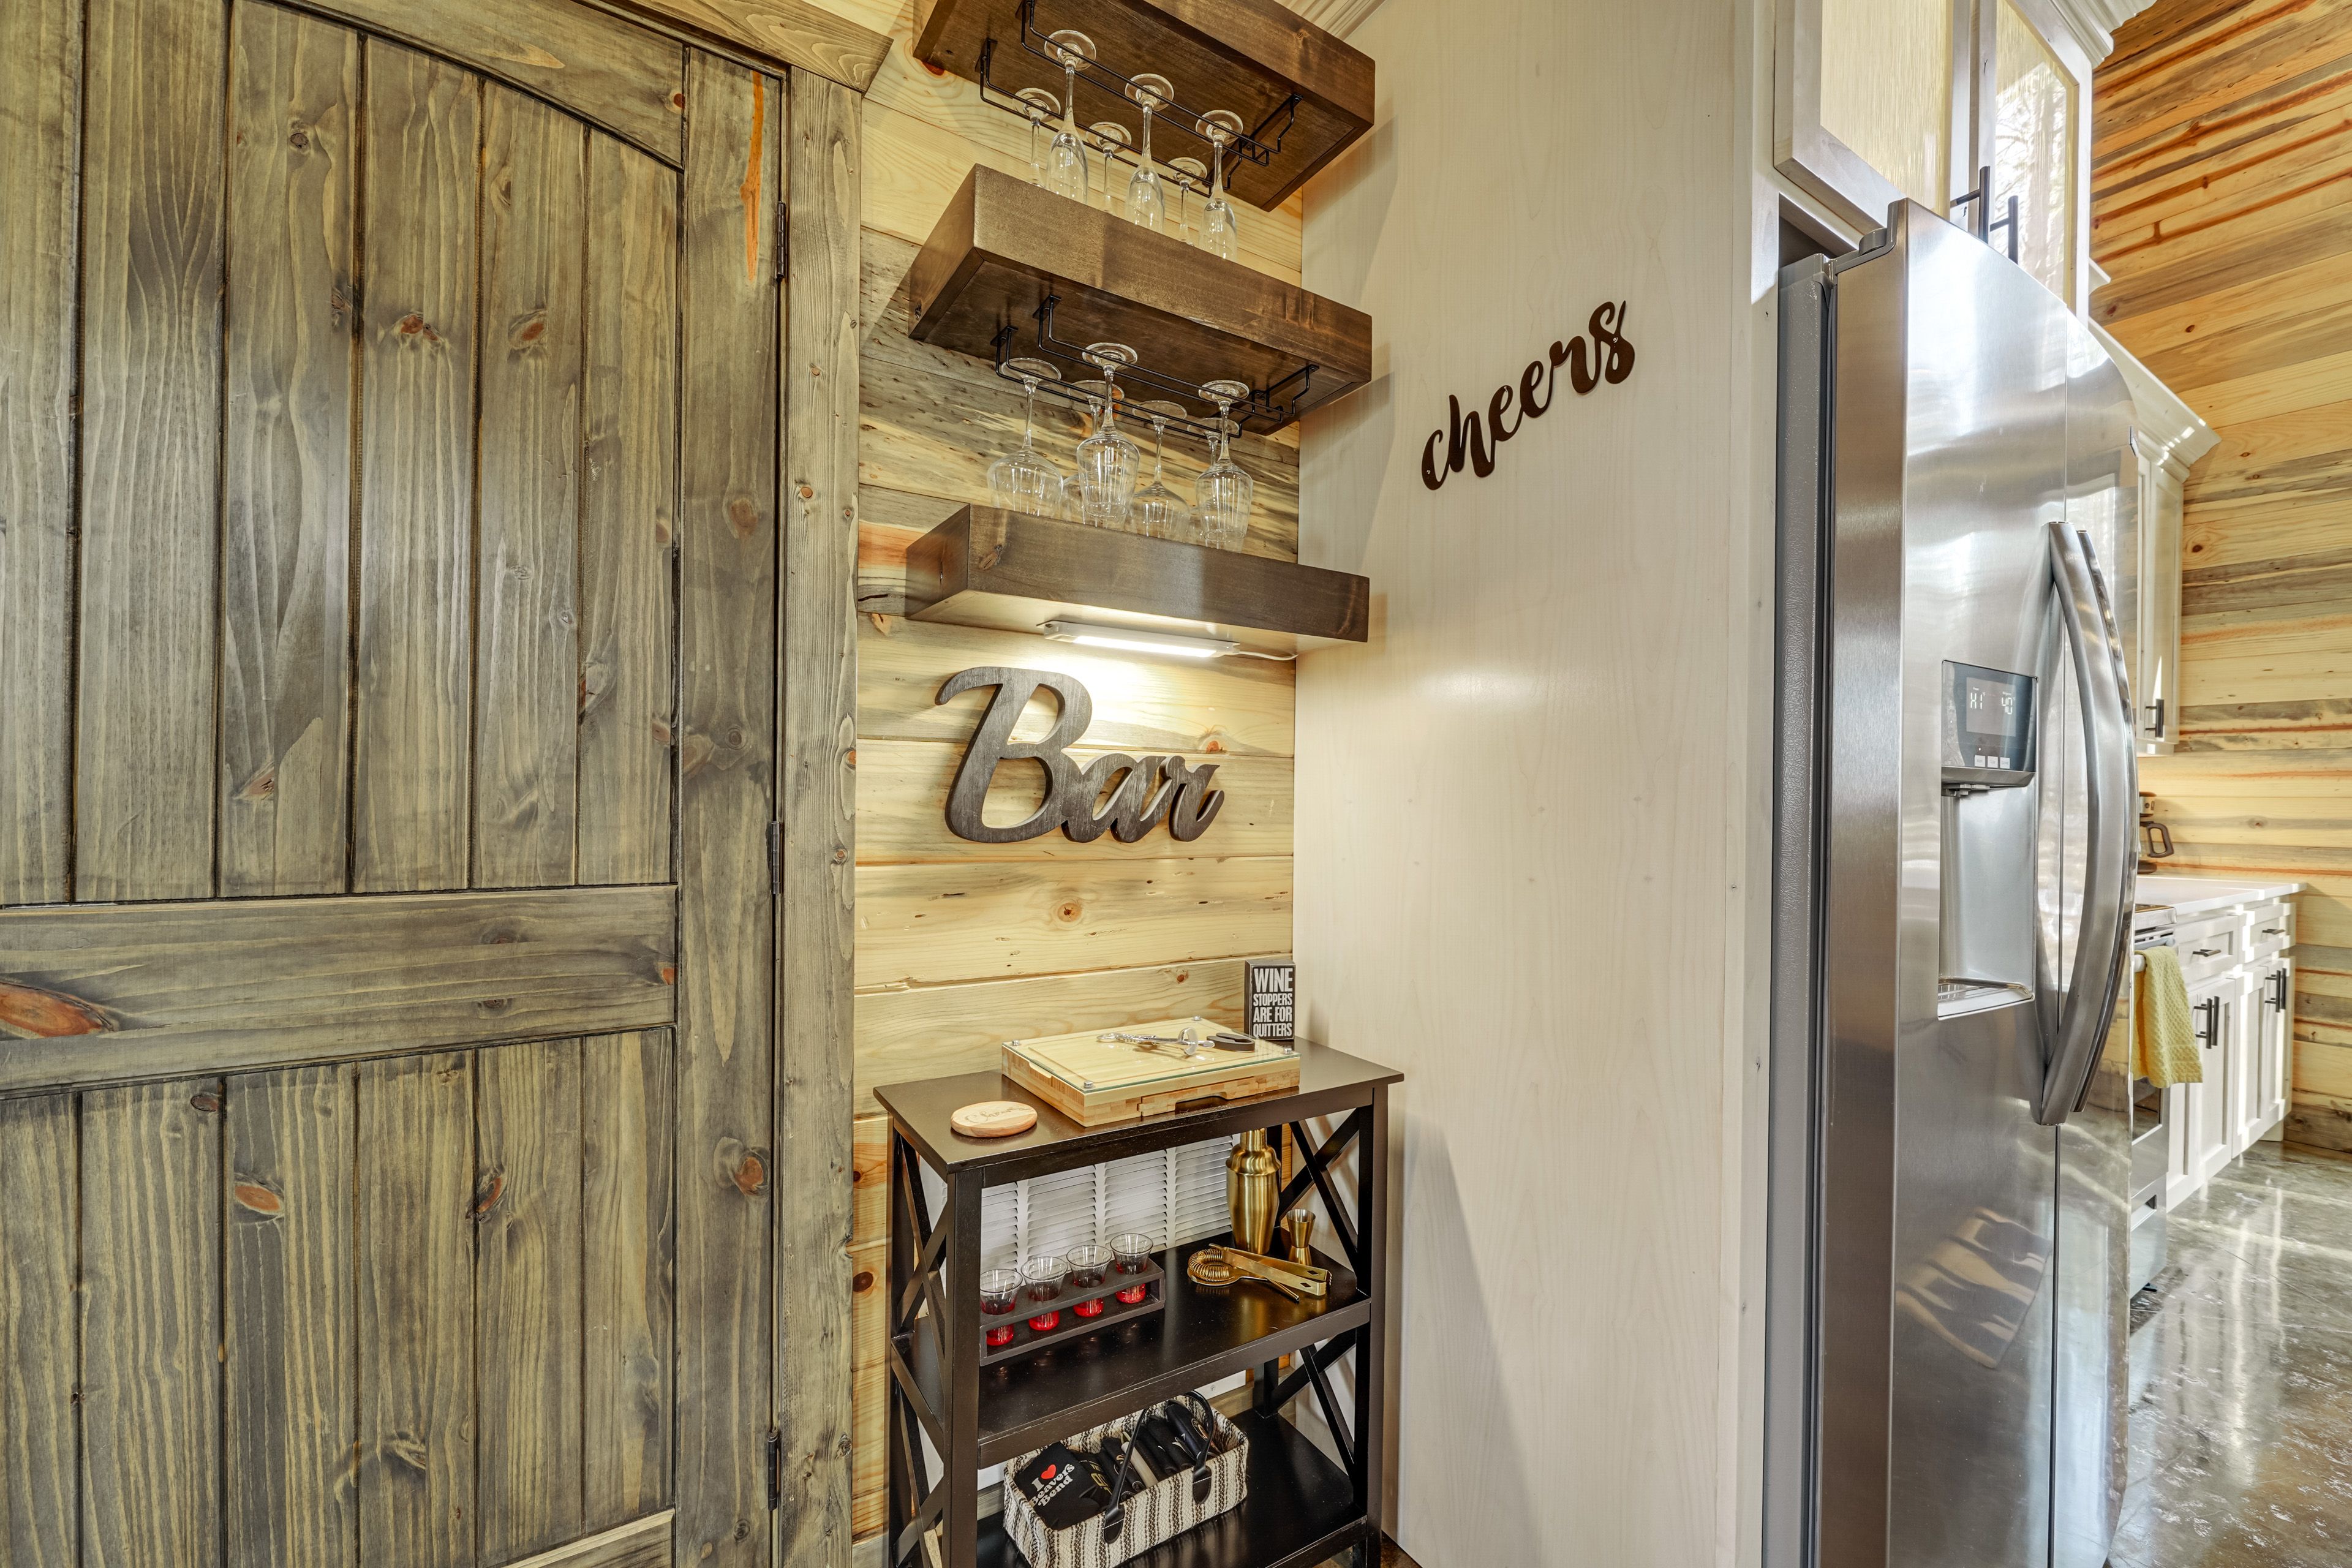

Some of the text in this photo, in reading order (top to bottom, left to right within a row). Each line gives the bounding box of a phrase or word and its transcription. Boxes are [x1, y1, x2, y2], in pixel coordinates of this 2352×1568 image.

[1422, 300, 1635, 490] cheers
[2001, 697, 2013, 715] 40
[935, 666, 1224, 843] Bar
[1253, 968, 1293, 993] WINE
[1253, 993, 1292, 1006] STOPPERS
[1253, 1006, 1292, 1022] ARE FOR
[1253, 1023, 1292, 1038] QUITTERS
[1029, 1464, 1075, 1507] Beavers
[1031, 1477, 1044, 1491] I
[1038, 1475, 1073, 1506] Bend
